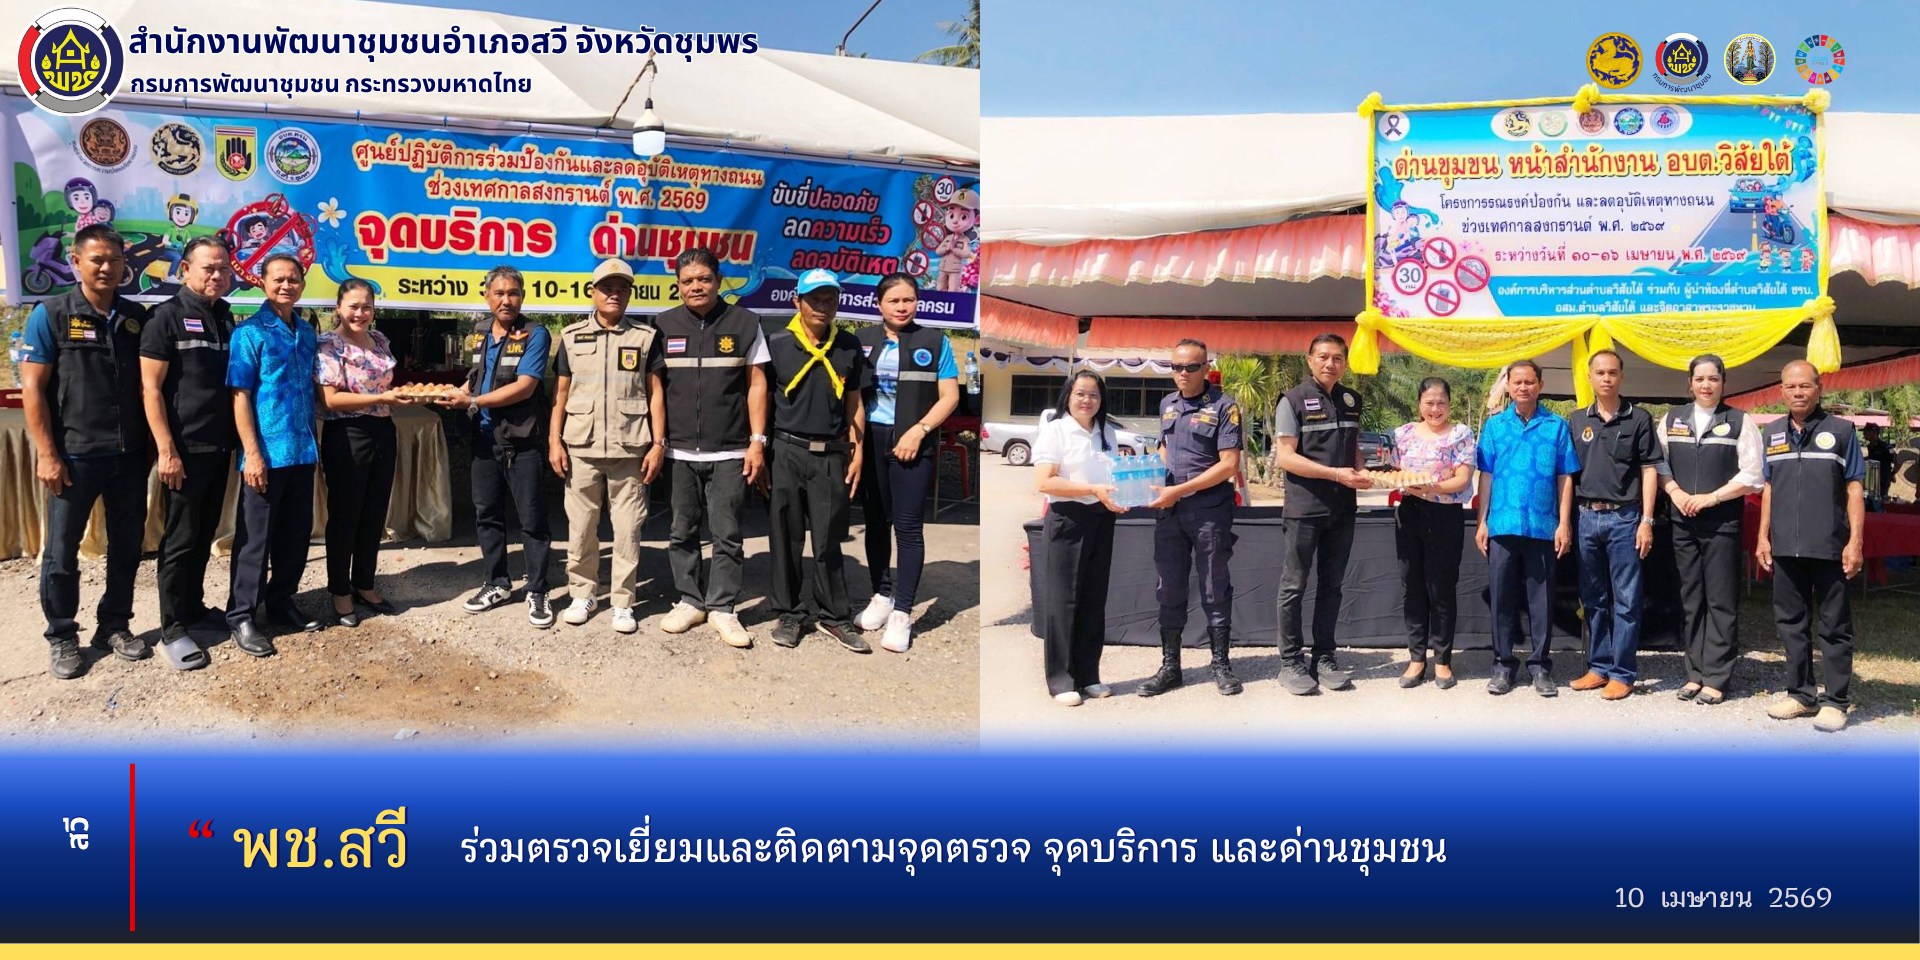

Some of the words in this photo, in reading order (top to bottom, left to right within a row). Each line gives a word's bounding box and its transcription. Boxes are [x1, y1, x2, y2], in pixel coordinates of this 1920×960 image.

[356, 137, 763, 188] ศูนย์ปฏิบัติการร่วมป้องกันและลดอุบัติเหตุทางถนน
[1508, 144, 1657, 174] หน้าสำนักงาน
[1666, 141, 1792, 172] อบต.วิสัยใต้
[427, 173, 612, 204] ช่วงเทศกาลสงกรานต์
[618, 189, 654, 206] พ.ศ.
[660, 189, 707, 210] 2569
[772, 178, 879, 212] ขับขี่ปลอดภัย
[937, 182, 953, 195] 30
[357, 211, 554, 261] จุดบริการ
[783, 216, 891, 244] ลดความเร็ว
[1598, 219, 1624, 232] พ.ศ.
[1630, 220, 1665, 232] ๒๕๖๙
[791, 247, 898, 275] ลดอบัติเหต
[1494, 242, 1566, 262] ระหว่างวันที่
[1626, 249, 1675, 261] เมษายน
[1682, 249, 1706, 261] พ.ศ.
[1713, 249, 1746, 261] ๒๕๖๙
[398, 274, 470, 296] ระหว่าง
[1399, 267, 1421, 283] 30
[1647, 281, 1680, 295] ร่วมกับ
